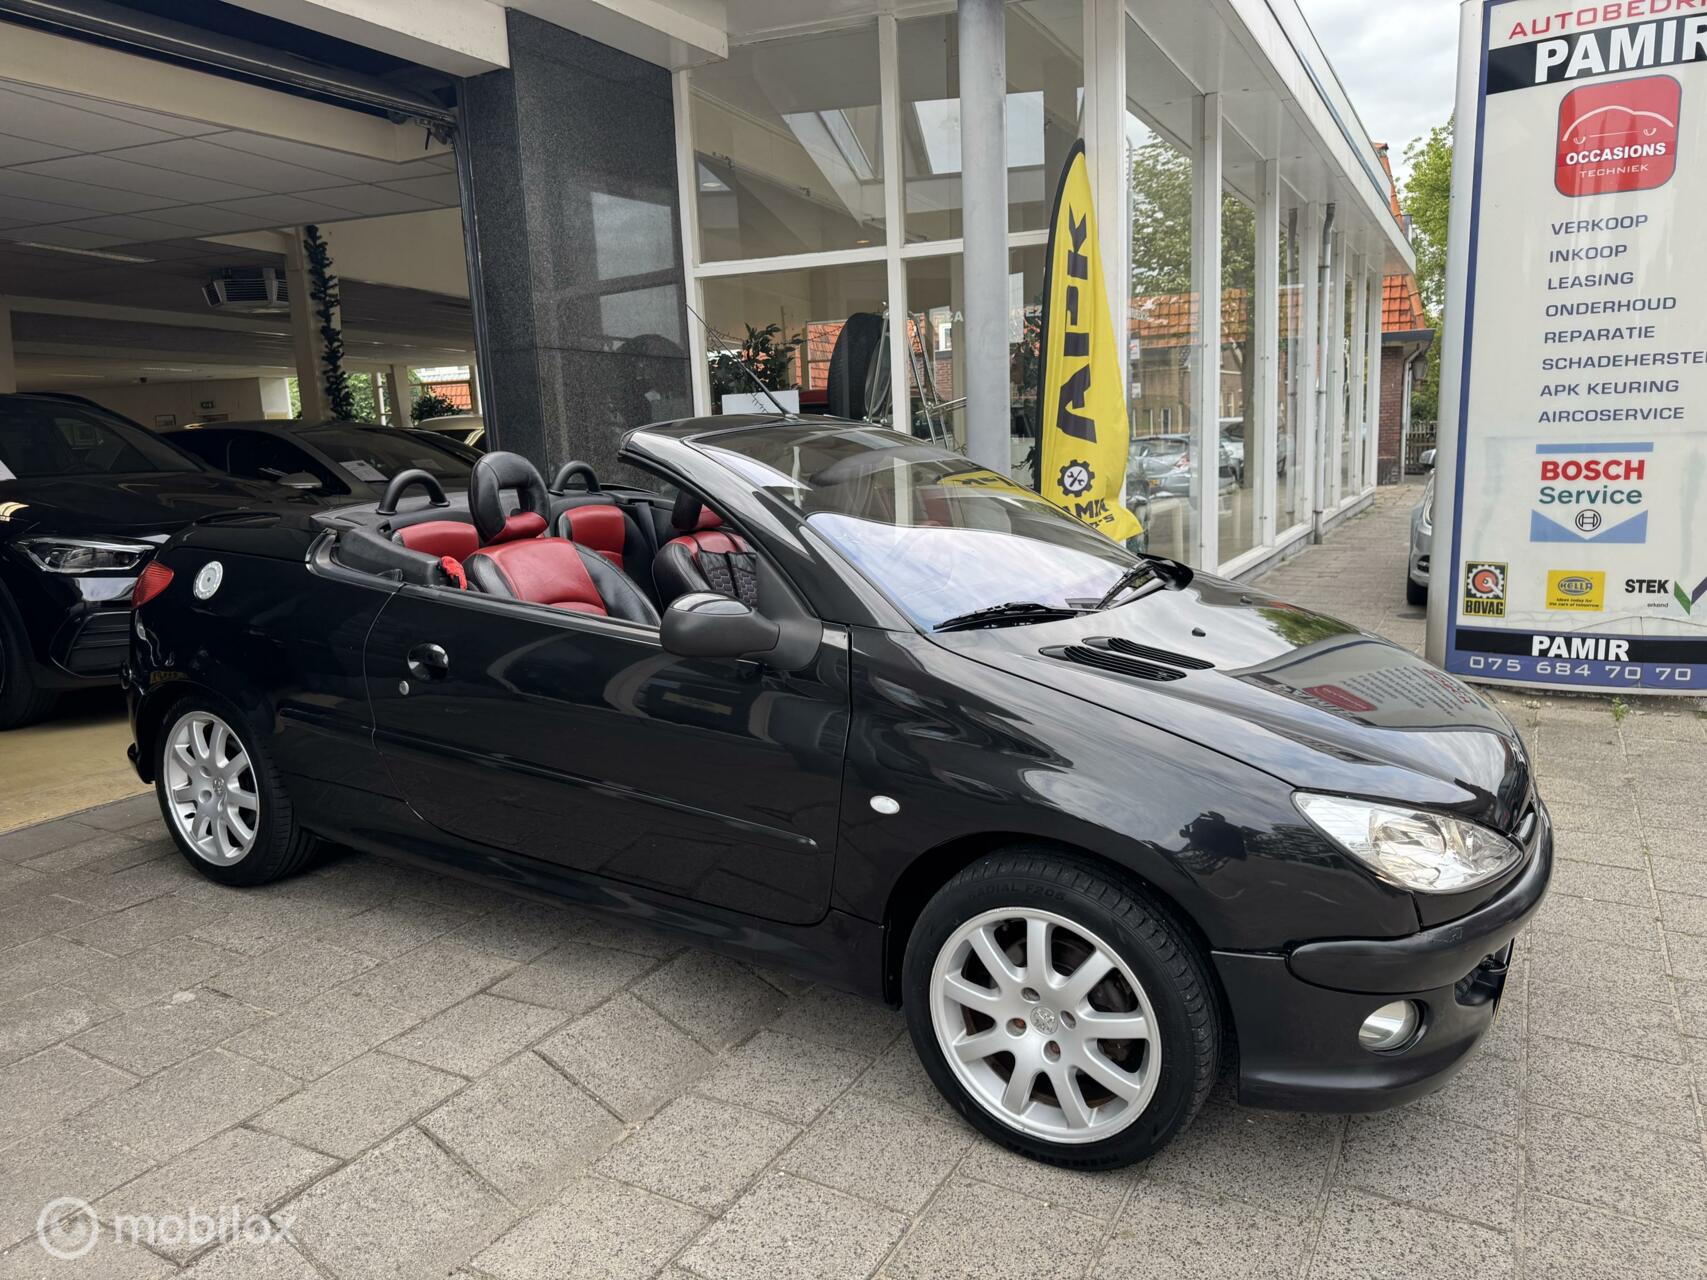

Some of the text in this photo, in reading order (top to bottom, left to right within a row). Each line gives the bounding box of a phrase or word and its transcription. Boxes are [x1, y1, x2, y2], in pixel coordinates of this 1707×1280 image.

[1534, 14, 1707, 84] PAMIR
[1565, 142, 1667, 166] OCCASIONS
[1579, 163, 1649, 179] TECHNIEK
[1551, 214, 1649, 236] VERKOOP
[1549, 244, 1628, 264] INKOOP
[1547, 271, 1635, 291] LEASING
[1545, 296, 1677, 318] ONDERHOUD
[1056, 201, 1098, 444] APK
[1543, 325, 1656, 344] REPARATIE
[1542, 350, 1707, 371] SCHADEHERSTE
[1540, 379, 1680, 397] APK KEURING
[1538, 407, 1685, 424] AIRCOSERVICE
[1540, 459, 1646, 481] BOSCH
[1538, 485, 1643, 505] Service
[1624, 579, 1669, 594] STEK
[1465, 600, 1504, 615] BOVAG
[1532, 635, 1629, 662] PAMIR
[1469, 655, 1692, 681] 075 684 70 70
